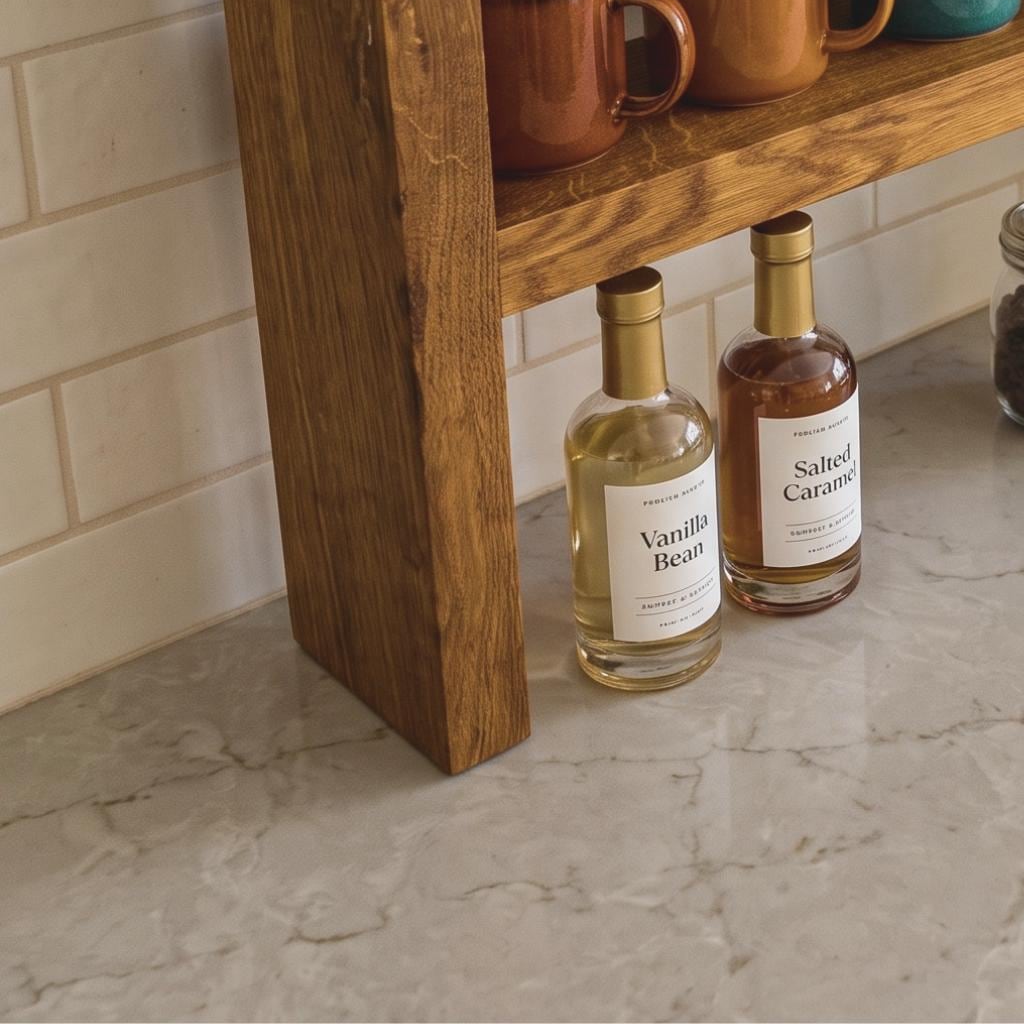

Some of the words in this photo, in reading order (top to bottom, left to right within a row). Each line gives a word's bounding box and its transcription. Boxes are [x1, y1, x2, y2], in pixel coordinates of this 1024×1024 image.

[794, 443, 851, 479] Salted
[783, 460, 857, 502] Caramel
[640, 512, 709, 549] Vanilla
[654, 542, 704, 572] Bean
